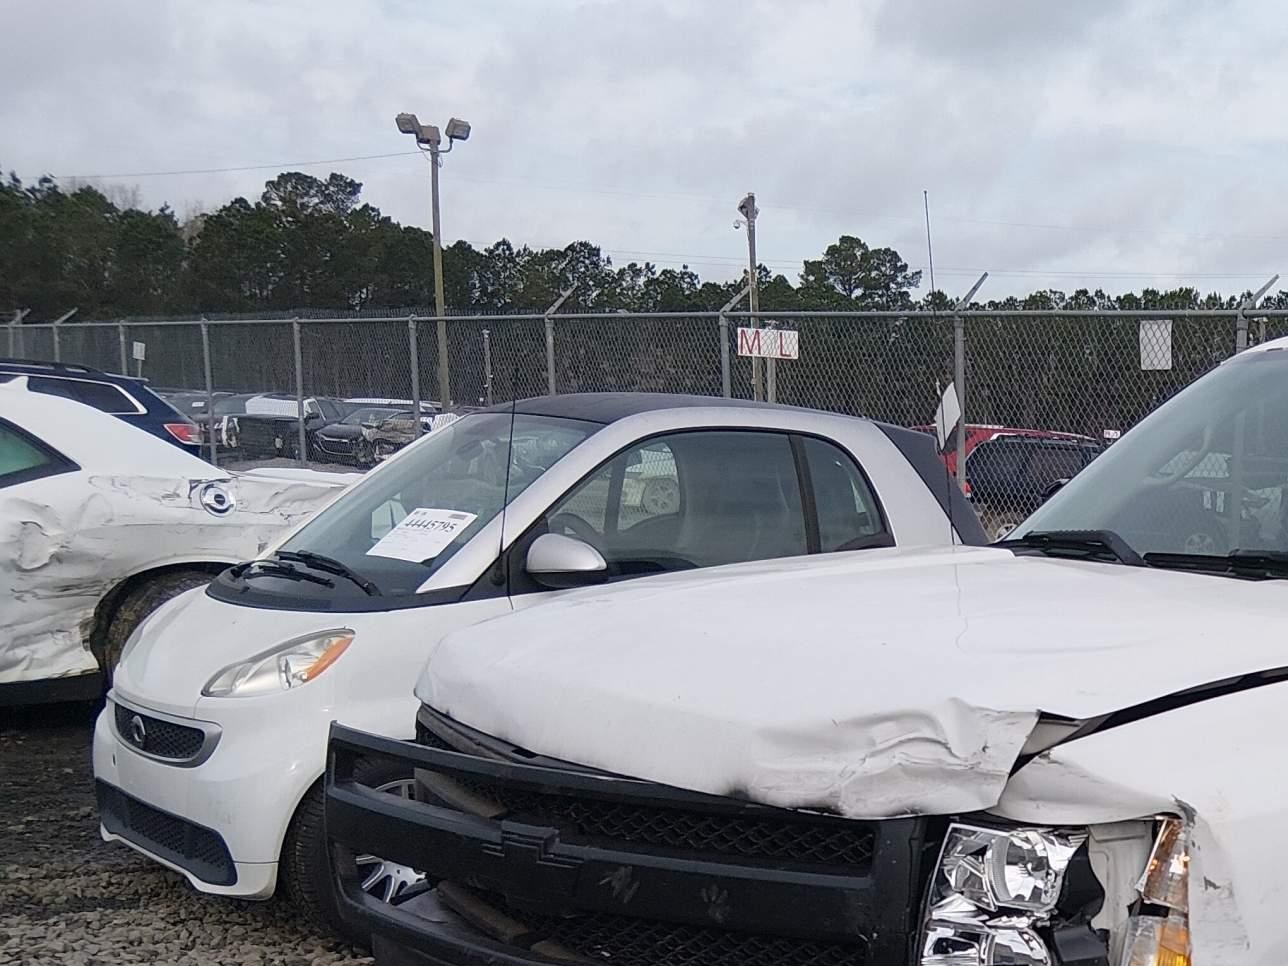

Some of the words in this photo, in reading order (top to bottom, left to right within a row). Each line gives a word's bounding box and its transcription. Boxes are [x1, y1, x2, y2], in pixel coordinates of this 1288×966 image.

[739, 329, 762, 355] M
[778, 331, 792, 357] L
[404, 518, 458, 533] 44445795
